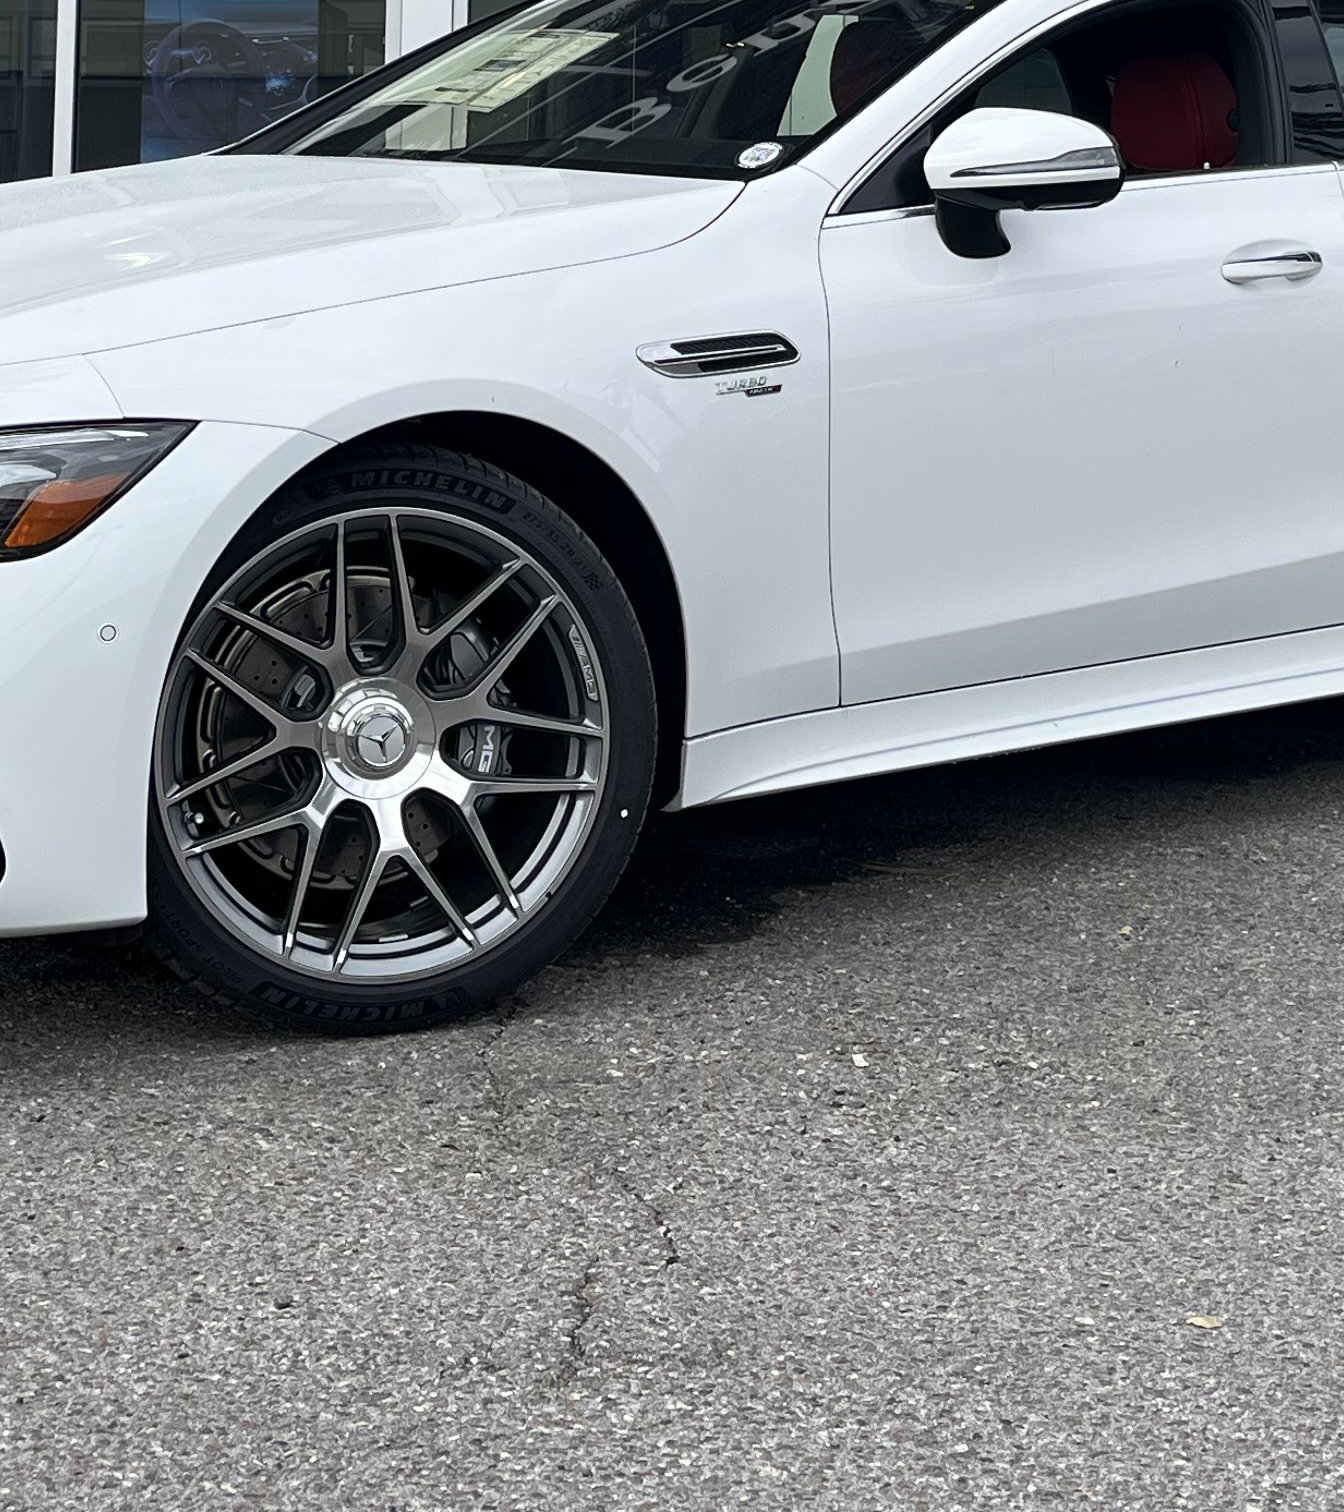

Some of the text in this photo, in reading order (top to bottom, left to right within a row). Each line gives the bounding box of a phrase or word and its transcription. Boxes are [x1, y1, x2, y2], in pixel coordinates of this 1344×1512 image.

[715, 376, 767, 392] TURBO
[351, 470, 506, 510] MICHELIN
[477, 725, 495, 774] MG
[259, 986, 425, 1022] MICHELIN
